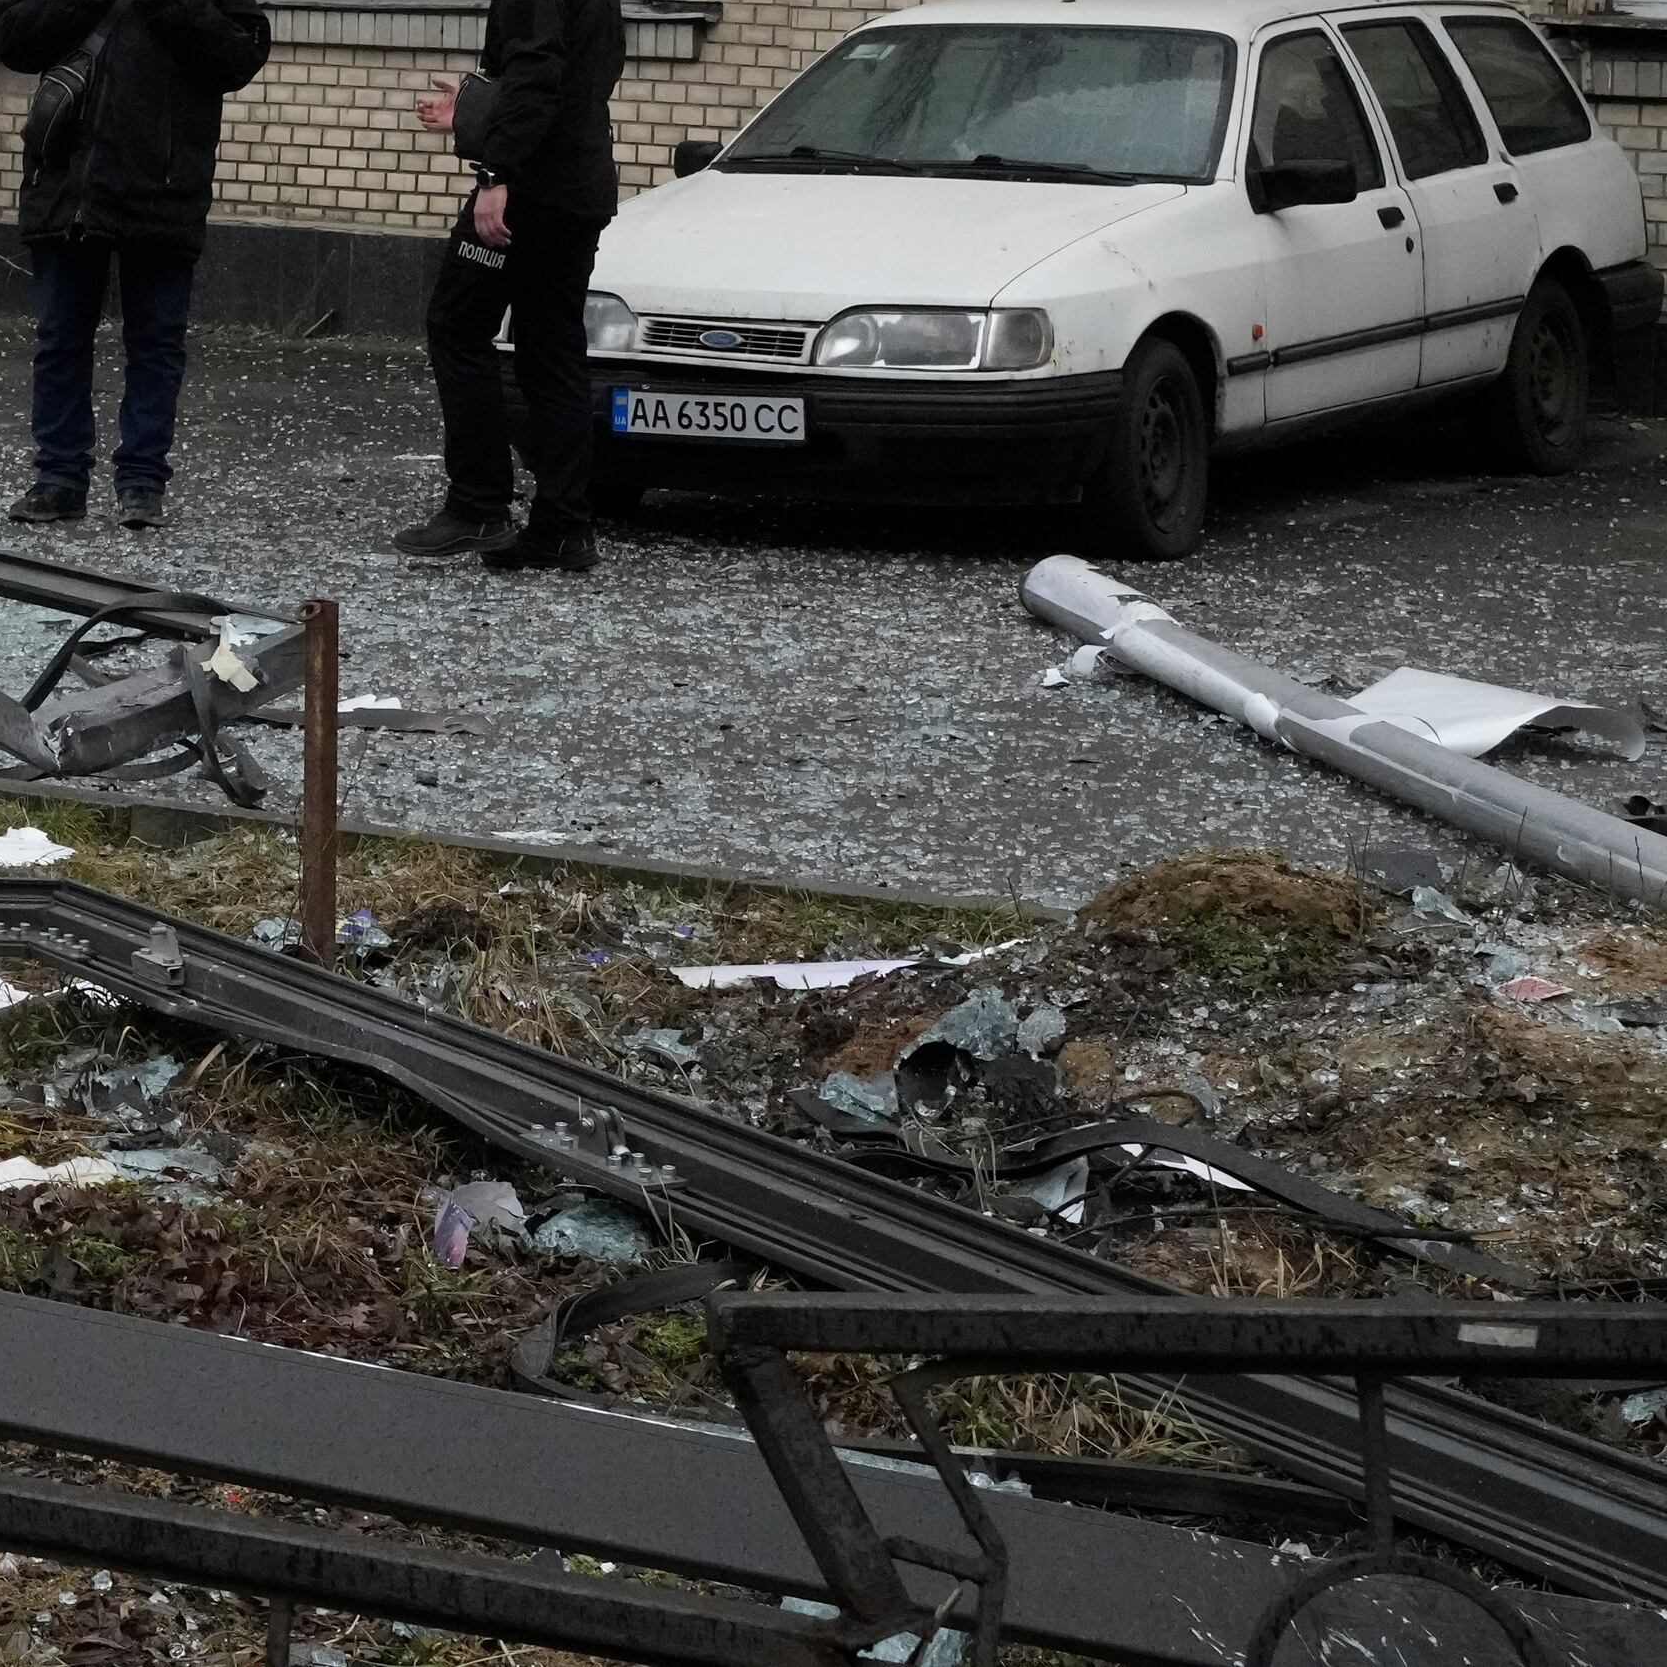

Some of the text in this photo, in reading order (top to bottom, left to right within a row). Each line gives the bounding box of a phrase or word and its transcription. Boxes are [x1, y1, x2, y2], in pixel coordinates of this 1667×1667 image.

[458, 240, 506, 270] ПОЛІЦІЯ
[615, 415, 627, 426] UA
[630, 398, 799, 434] AA 6350 CC
